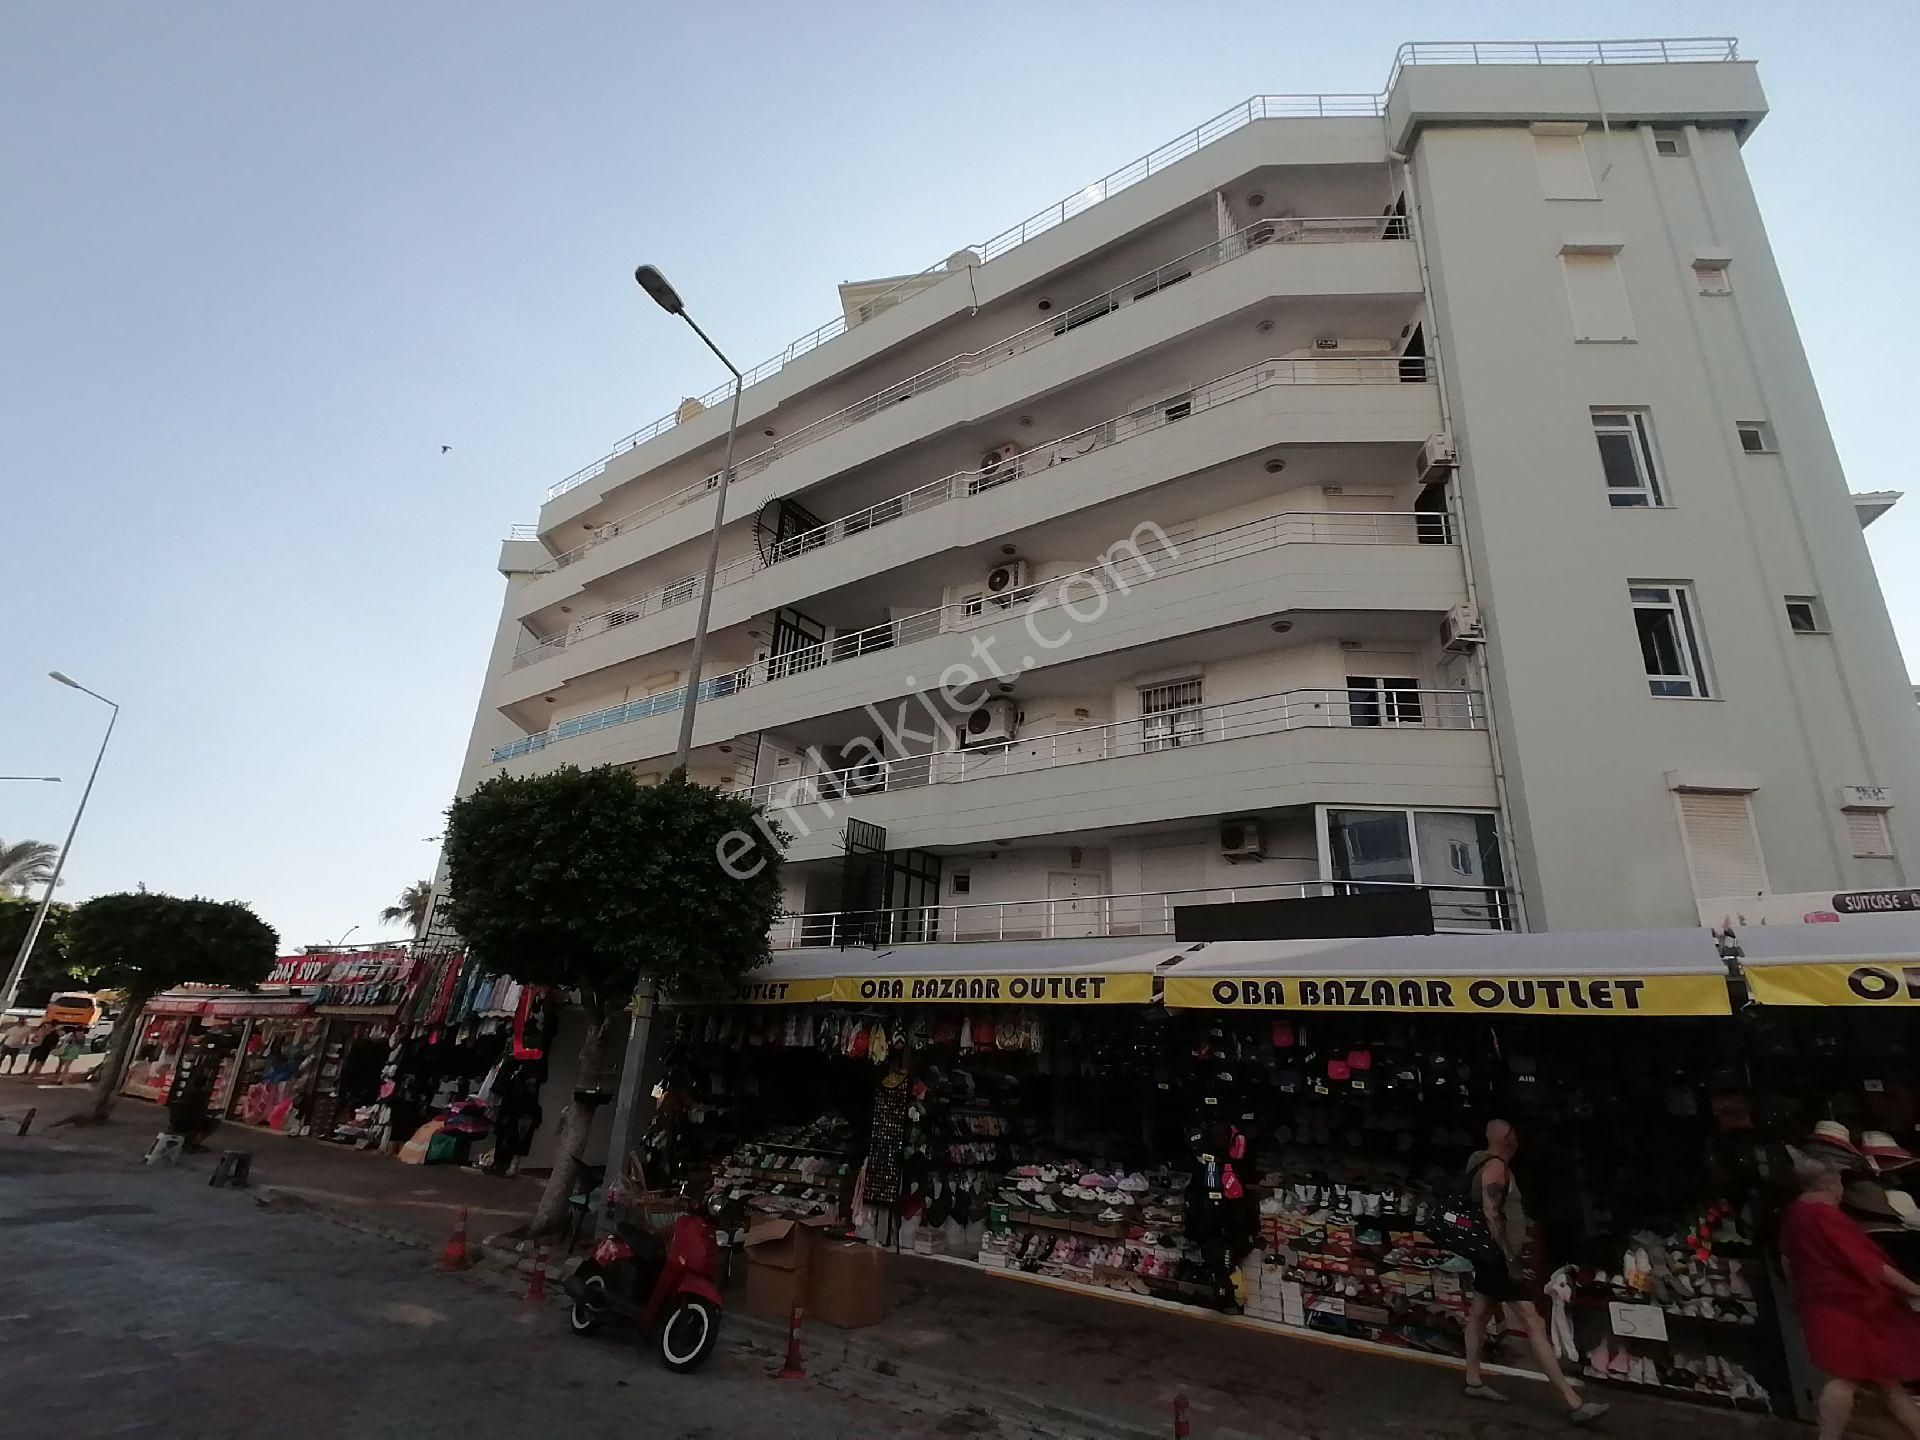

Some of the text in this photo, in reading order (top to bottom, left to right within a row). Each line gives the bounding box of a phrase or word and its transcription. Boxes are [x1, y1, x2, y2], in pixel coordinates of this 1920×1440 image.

[1845, 895, 1901, 911] SUITCASE
[729, 983, 789, 1001] UTLET
[860, 977, 1106, 999] OBA BAZAAR OUTLET
[1212, 979, 1644, 1009] OBA BAZAAR OUTLET
